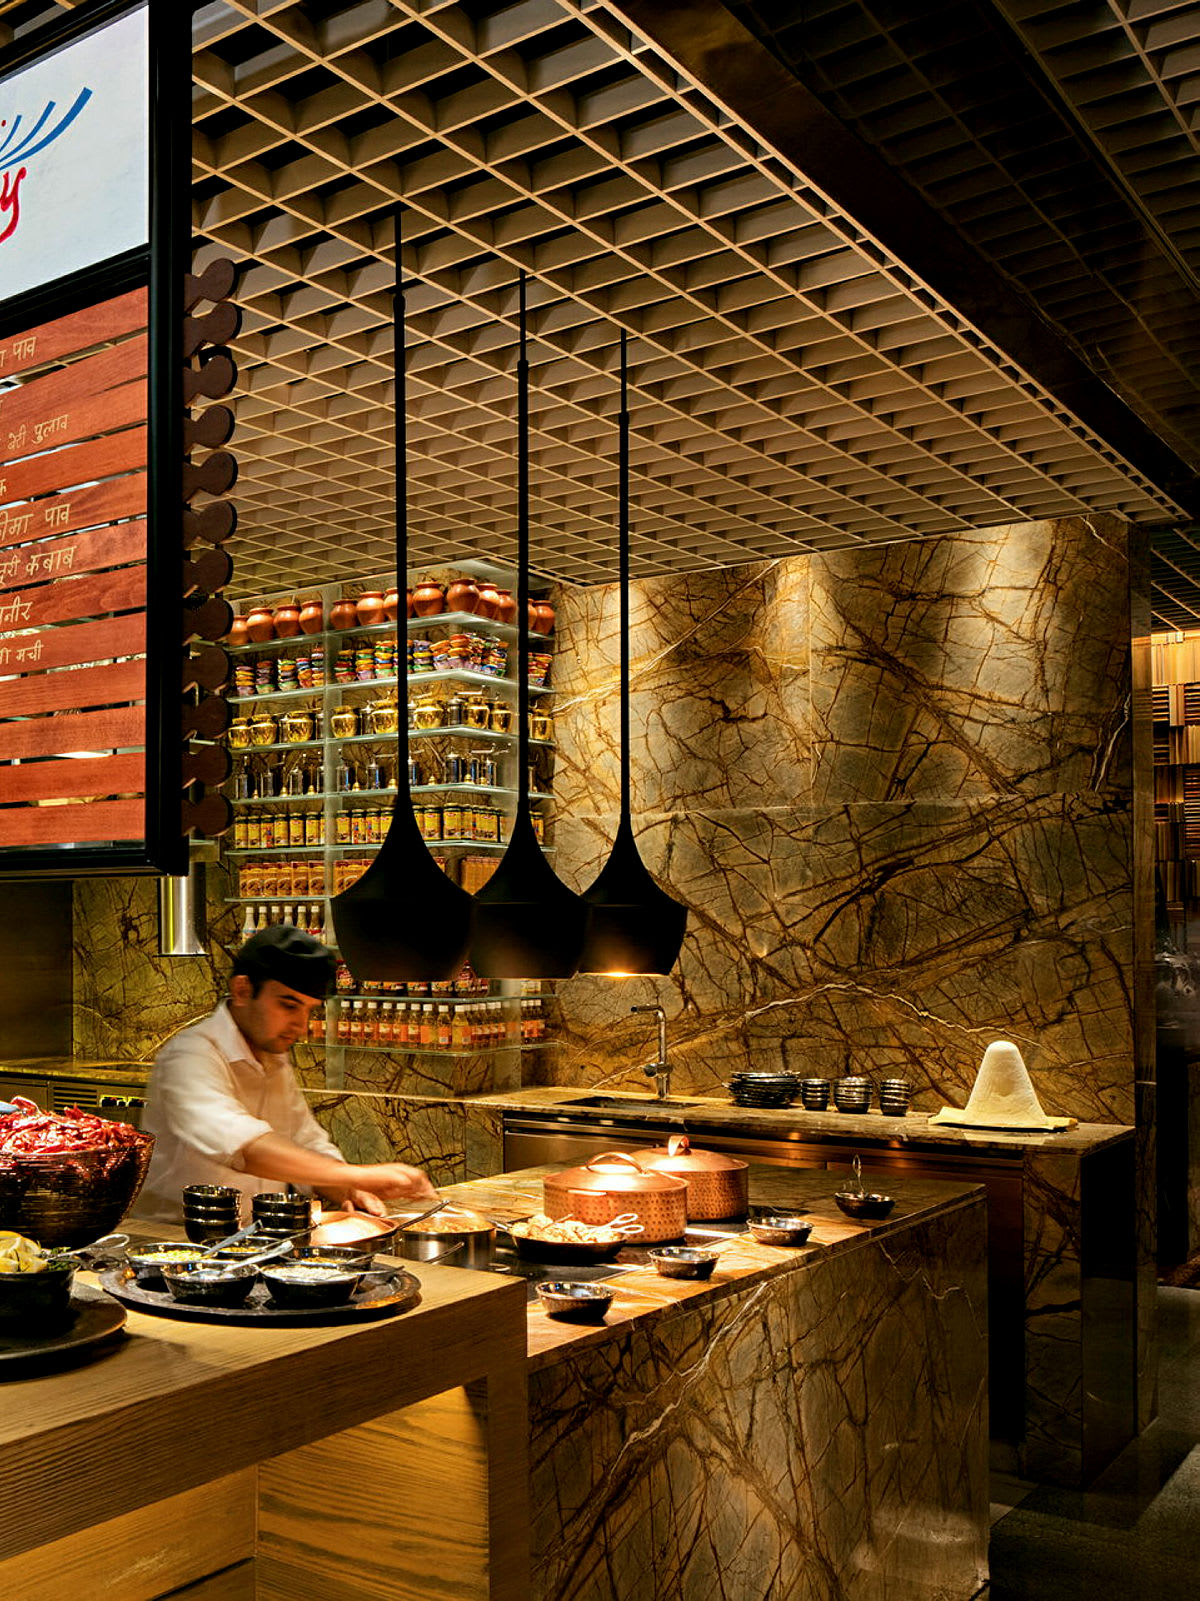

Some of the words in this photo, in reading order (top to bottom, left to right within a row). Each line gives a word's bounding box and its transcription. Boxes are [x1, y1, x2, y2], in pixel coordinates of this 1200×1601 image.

[12, 336, 37, 360] पाव
[45, 503, 71, 528] पाव
[25, 545, 77, 576] कबाब
